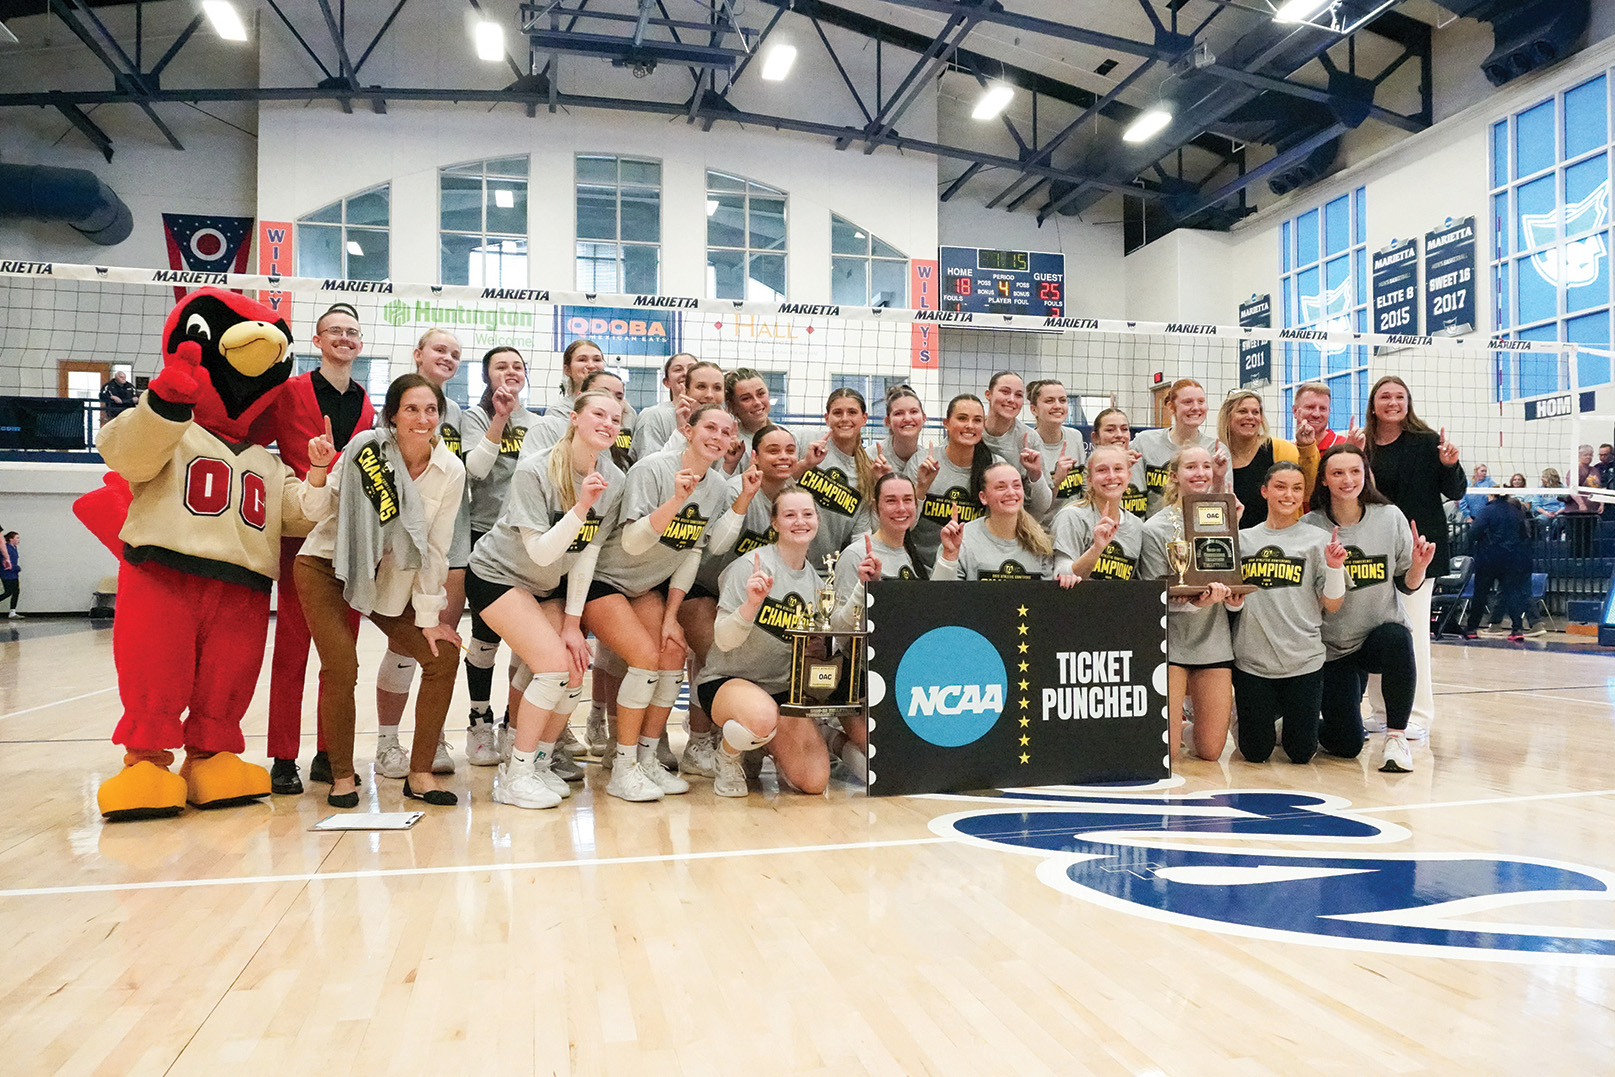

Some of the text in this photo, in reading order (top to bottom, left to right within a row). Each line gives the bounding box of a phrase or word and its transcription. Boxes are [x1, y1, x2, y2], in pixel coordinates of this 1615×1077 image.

[1427, 226, 1473, 251] MARIETTA
[1374, 247, 1416, 270] MARIETTA
[152, 270, 228, 285] MARIETTA
[947, 267, 973, 277] HOME
[1033, 272, 1063, 283] GUEST
[321, 279, 393, 294] MARIETTA
[955, 277, 971, 295] 18
[998, 280, 1009, 296] 4
[1429, 271, 1458, 292] SWEET
[481, 287, 550, 301] MARIETTA
[943, 294, 964, 302] FOULS
[1039, 282, 1060, 300] 25
[1376, 286, 1414, 309] ELITE 8
[633, 295, 699, 309] MARIETTA
[778, 303, 840, 316] MARIETTA
[988, 297, 1012, 305] PLAYER
[1043, 300, 1063, 308] FOULS
[1240, 301, 1270, 319] MARIETTA
[1433, 288, 1467, 316] 2017
[415, 300, 532, 331] Huntington
[914, 310, 973, 323] MARIETTA
[1043, 317, 1098, 330] MARIETTA
[1380, 306, 1410, 331] 2015
[567, 317, 666, 338] QDOBA
[734, 313, 798, 339] HALL
[1164, 323, 1217, 335] MARIETTA
[1279, 328, 1328, 341] MARIETTA
[1385, 335, 1433, 346] MARIETTA
[1487, 340, 1531, 350] MARIETTA
[1245, 351, 1265, 370] 2011
[1536, 397, 1571, 418] HOM
[358, 446, 397, 522] CHAMONS
[800, 470, 858, 514] CHAMPIONS
[1092, 557, 1134, 580] AMPIONS
[1241, 562, 1302, 583] CHAMPIONS
[1346, 563, 1385, 579] PIONS
[1056, 650, 1133, 684] TICKET
[908, 684, 1001, 716] NCAA
[1042, 685, 1148, 721] PUNCHED
